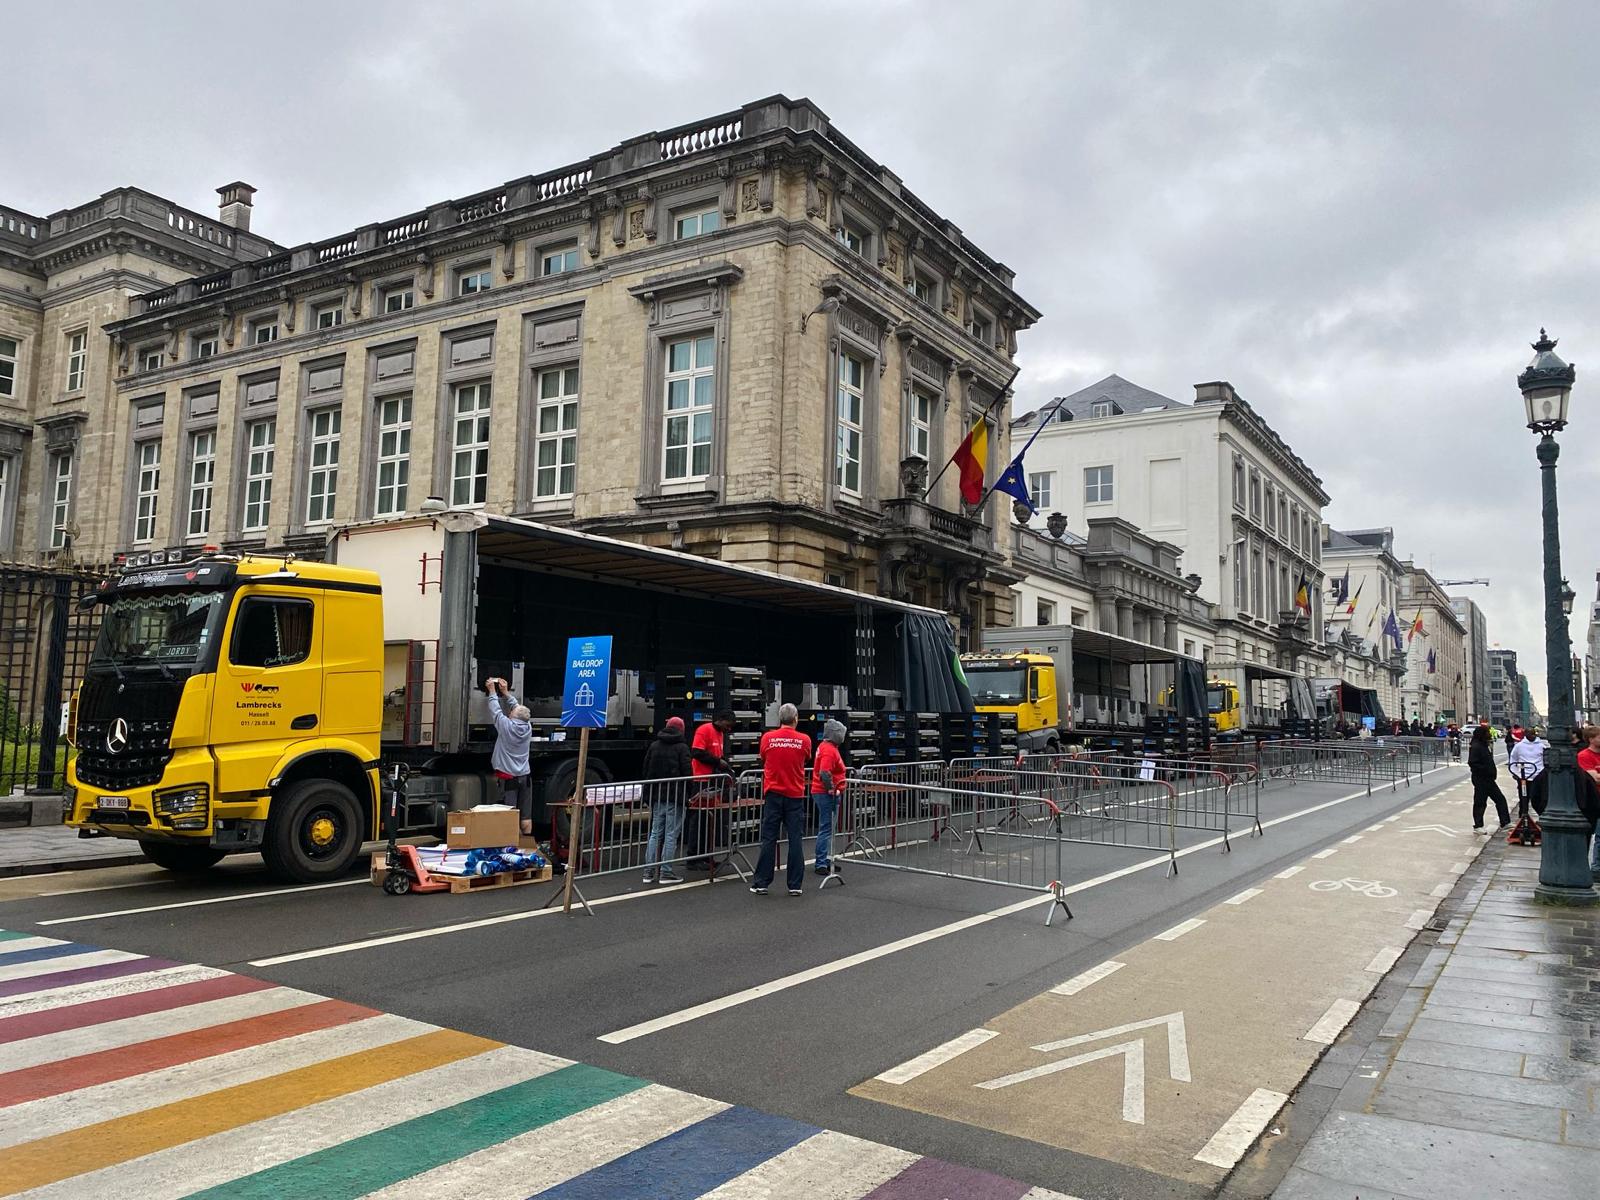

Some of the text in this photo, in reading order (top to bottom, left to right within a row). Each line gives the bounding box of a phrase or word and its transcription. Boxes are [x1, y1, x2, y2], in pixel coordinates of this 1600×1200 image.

[166, 647, 190, 656] JORDY
[572, 659, 604, 668] BAG DROP
[578, 669, 596, 678] AREA
[236, 701, 282, 709] Lambrecks
[769, 742, 803, 750] CHAMPIONS
